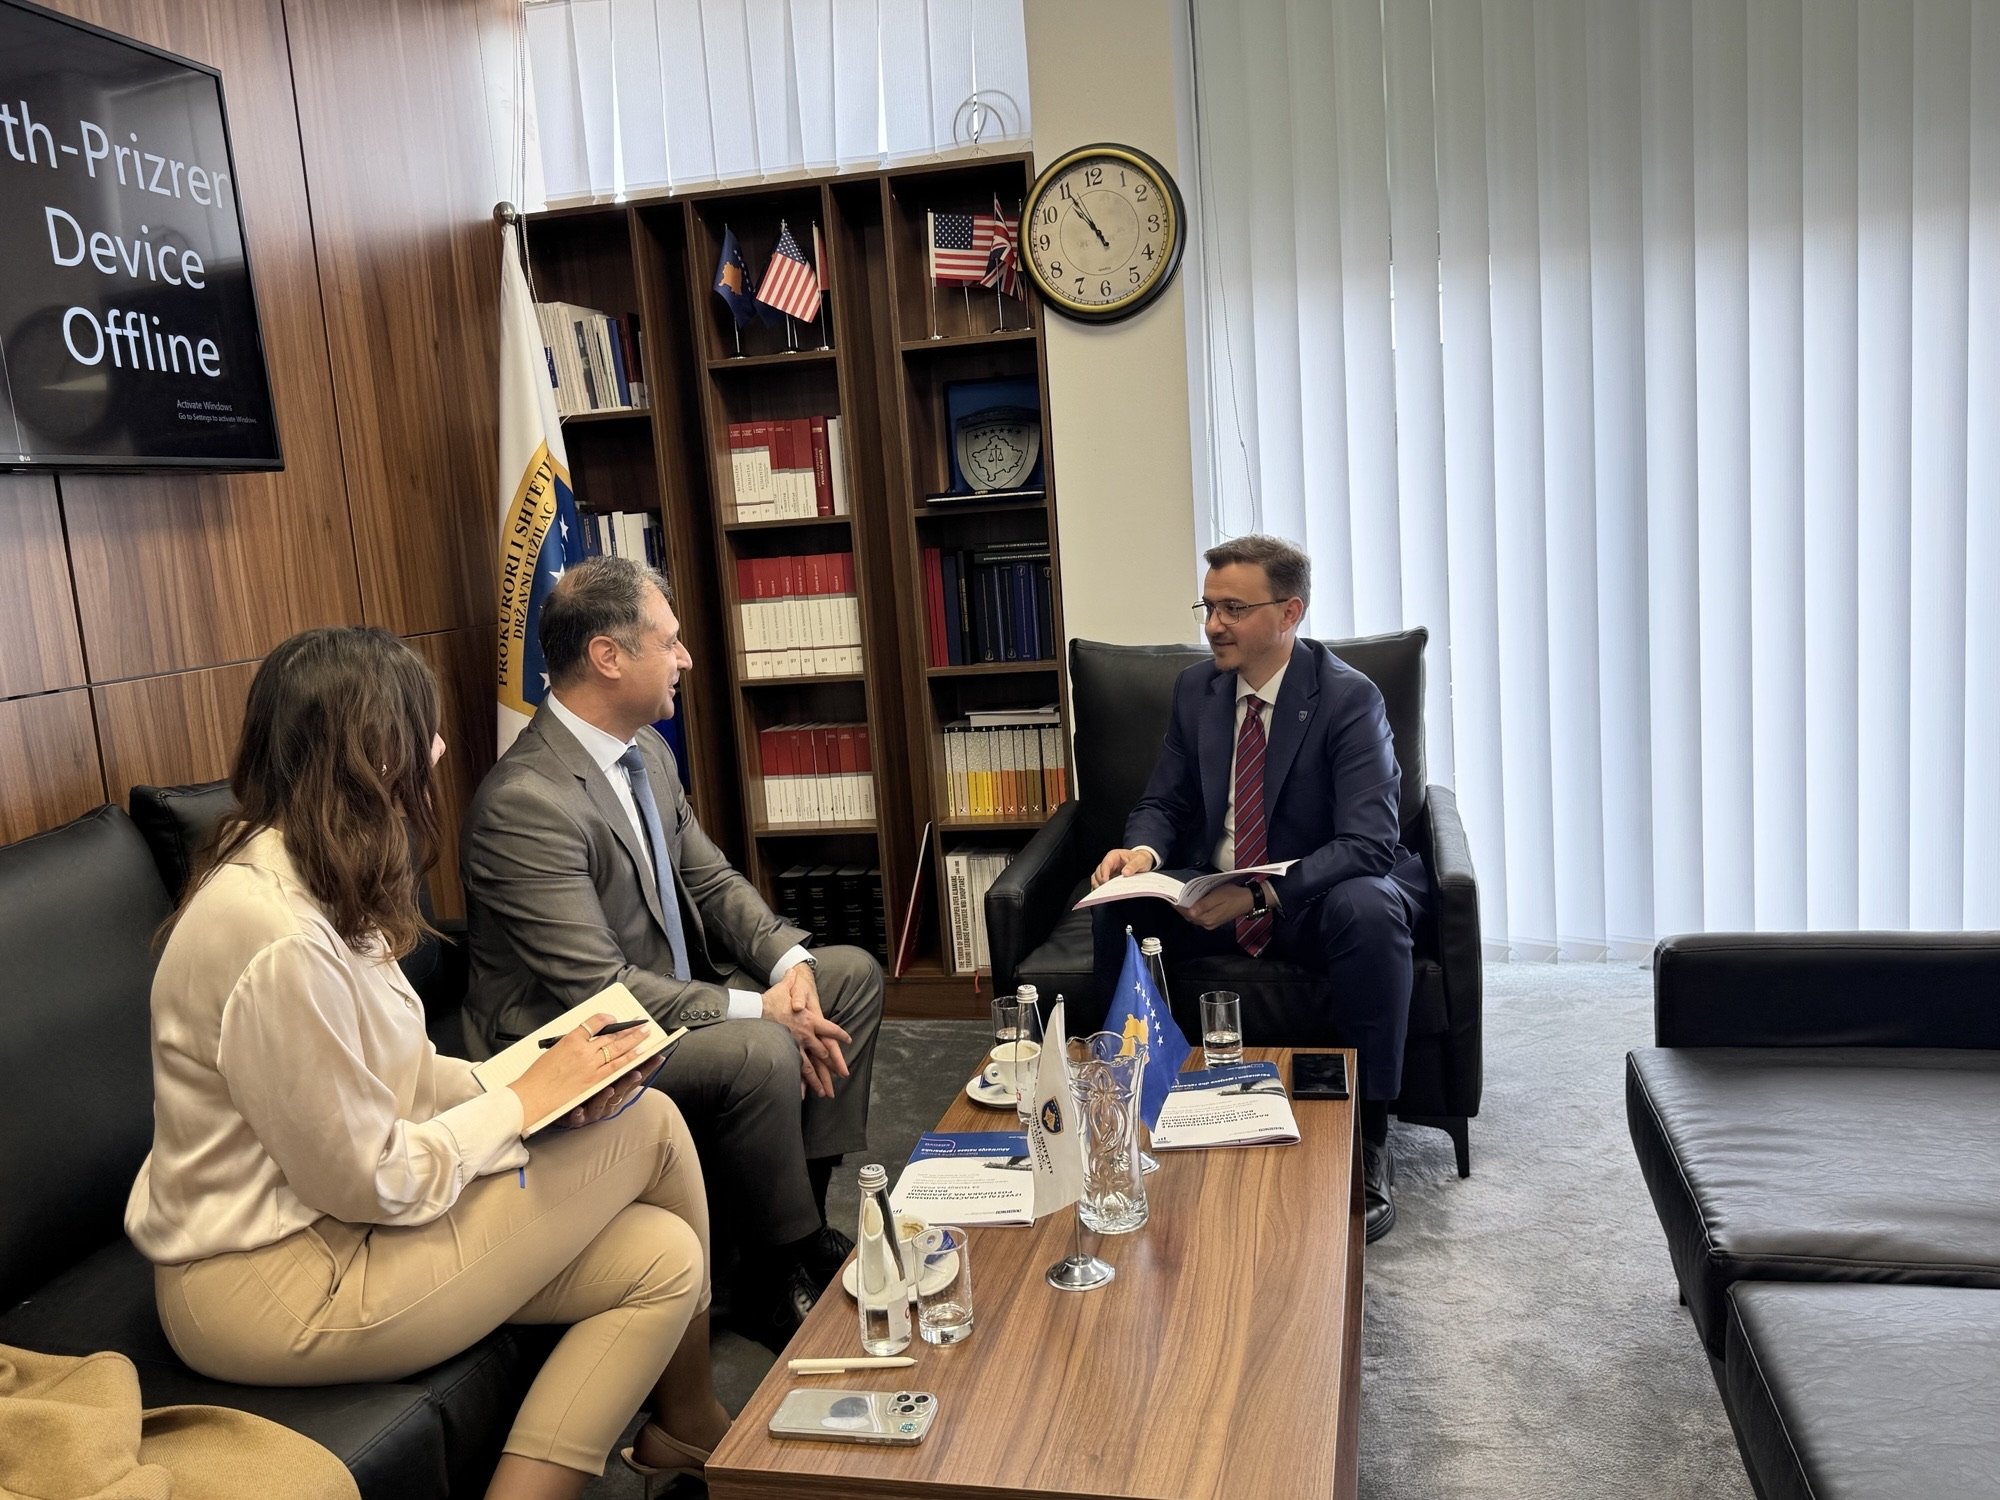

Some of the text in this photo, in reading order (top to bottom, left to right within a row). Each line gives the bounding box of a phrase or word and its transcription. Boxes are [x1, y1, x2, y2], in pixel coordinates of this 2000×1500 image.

[1085, 168, 1103, 187] 12
[1120, 171, 1126, 187] 1
[1060, 182, 1072, 200] 11
[1135, 185, 1148, 202] 2
[1042, 206, 1057, 225] 10
[1148, 215, 1160, 233] 3
[45, 206, 205, 289] Device
[1040, 235, 1050, 251] 9
[1141, 244, 1154, 260] 4
[1051, 261, 1063, 278] 8
[1129, 266, 1140, 283] 5
[1074, 277, 1085, 295] 7
[1101, 280, 1111, 296] 6
[62, 307, 221, 377] Offline
[177, 400, 232, 411] Activate Windows
[193, 414, 212, 423] Settings
[514, 502, 554, 640] DRŽAVNI TUŽILAC
[498, 554, 521, 687] PROKURORI
[511, 540, 524, 551] I
